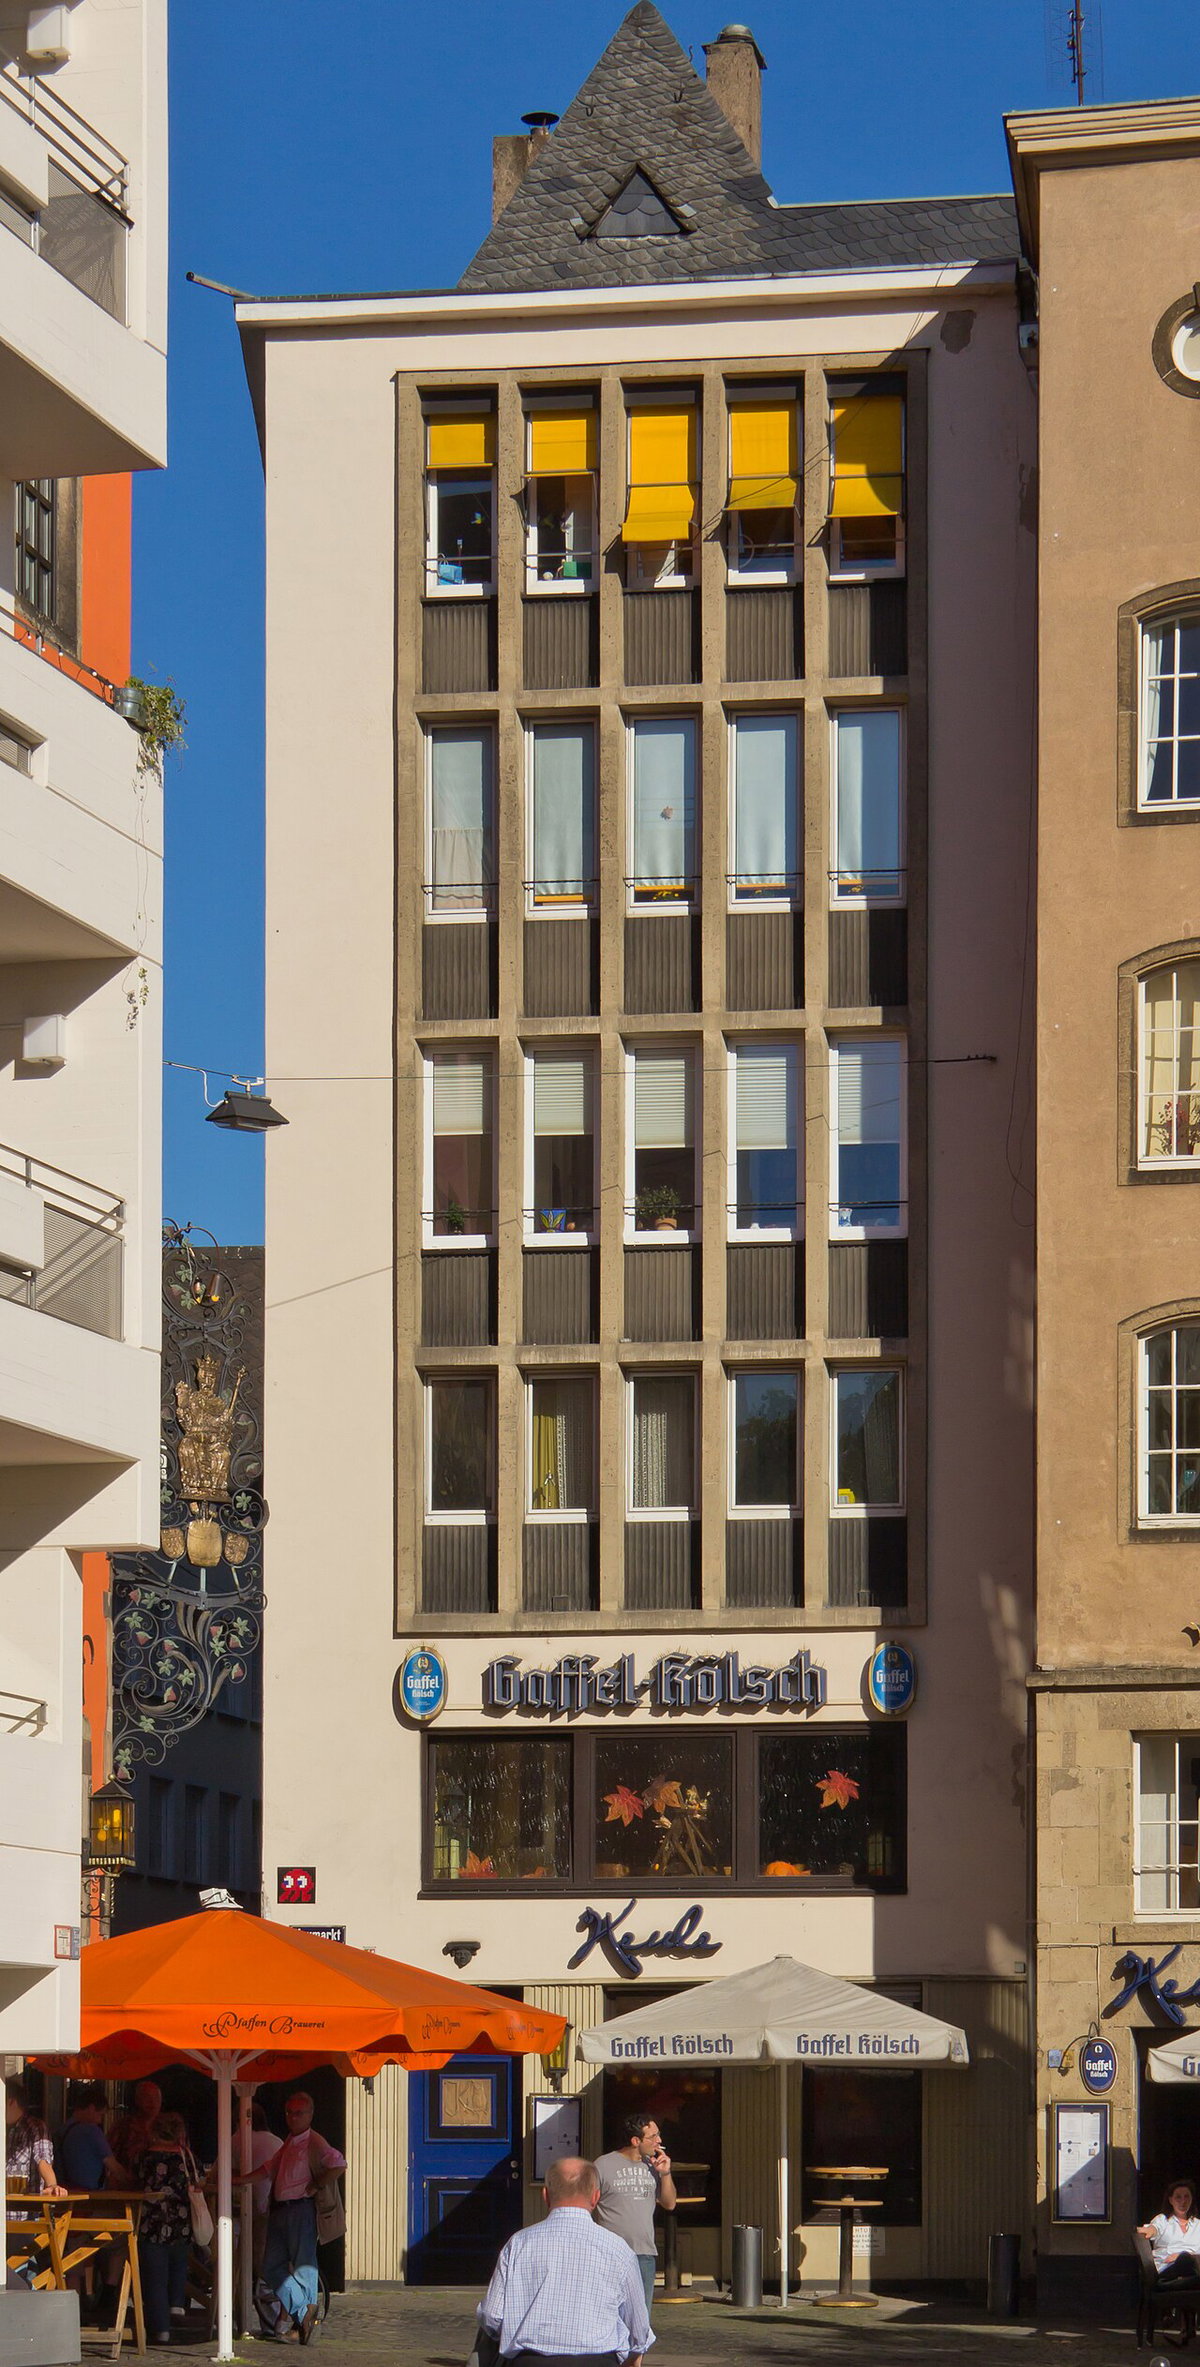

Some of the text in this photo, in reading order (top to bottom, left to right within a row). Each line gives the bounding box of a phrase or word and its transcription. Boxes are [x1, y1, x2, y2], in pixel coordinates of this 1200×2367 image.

[406, 1675, 440, 1690] Gaffel
[876, 1669, 910, 1683] Gaffel
[202, 2011, 325, 2038] Pfaffen Brauerei
[610, 2033, 734, 2058] Gaffel Kölsch
[796, 2034, 920, 2056] Gaffel Kölsch
[1085, 2059, 1113, 2071] Gaffel
